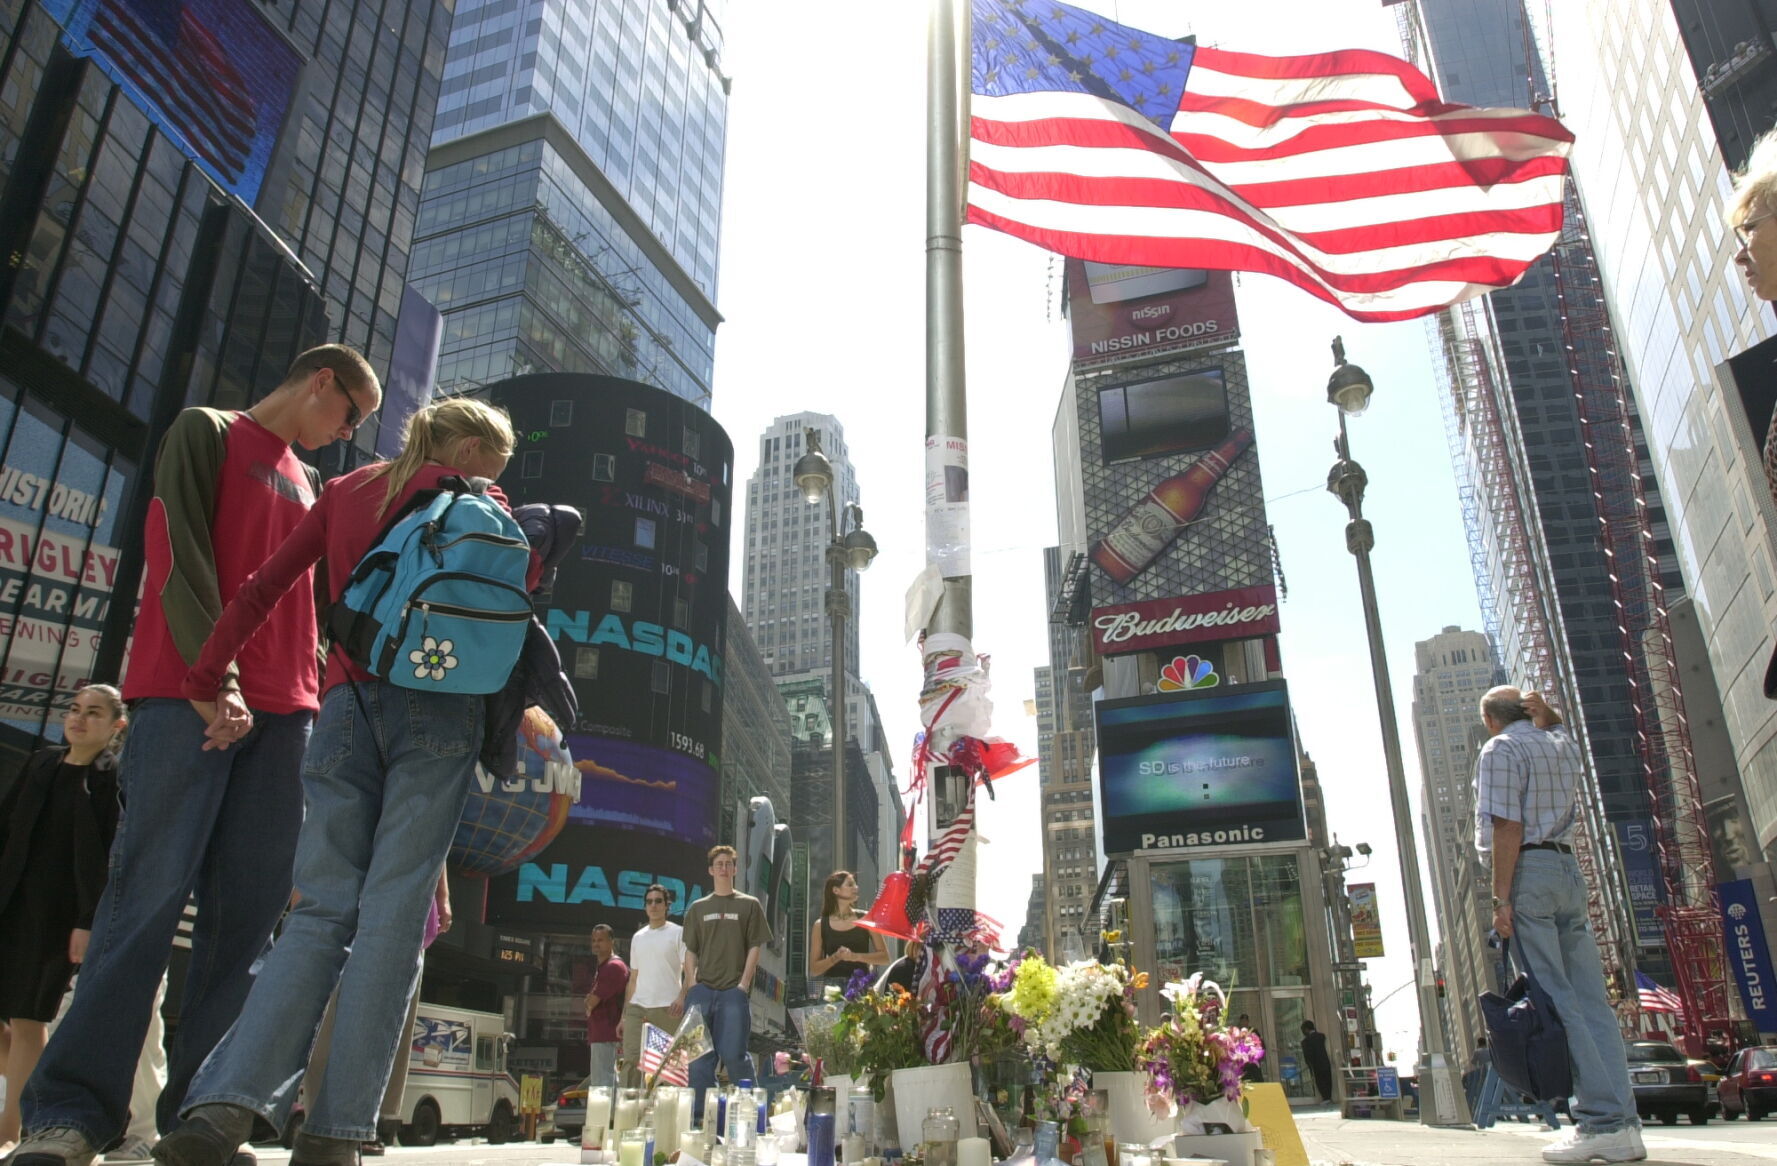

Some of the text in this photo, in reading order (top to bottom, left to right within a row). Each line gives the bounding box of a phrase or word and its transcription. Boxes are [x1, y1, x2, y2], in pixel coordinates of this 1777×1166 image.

[1091, 319, 1218, 354] NISSIN FOODS
[625, 492, 670, 518] XILINX
[1095, 602, 1276, 644] Budweiser
[671, 731, 705, 760] 1593.68
[1139, 760, 1165, 775] SD
[1142, 825, 1265, 849] Panasonic
[1734, 923, 1767, 1010] REUTERS
